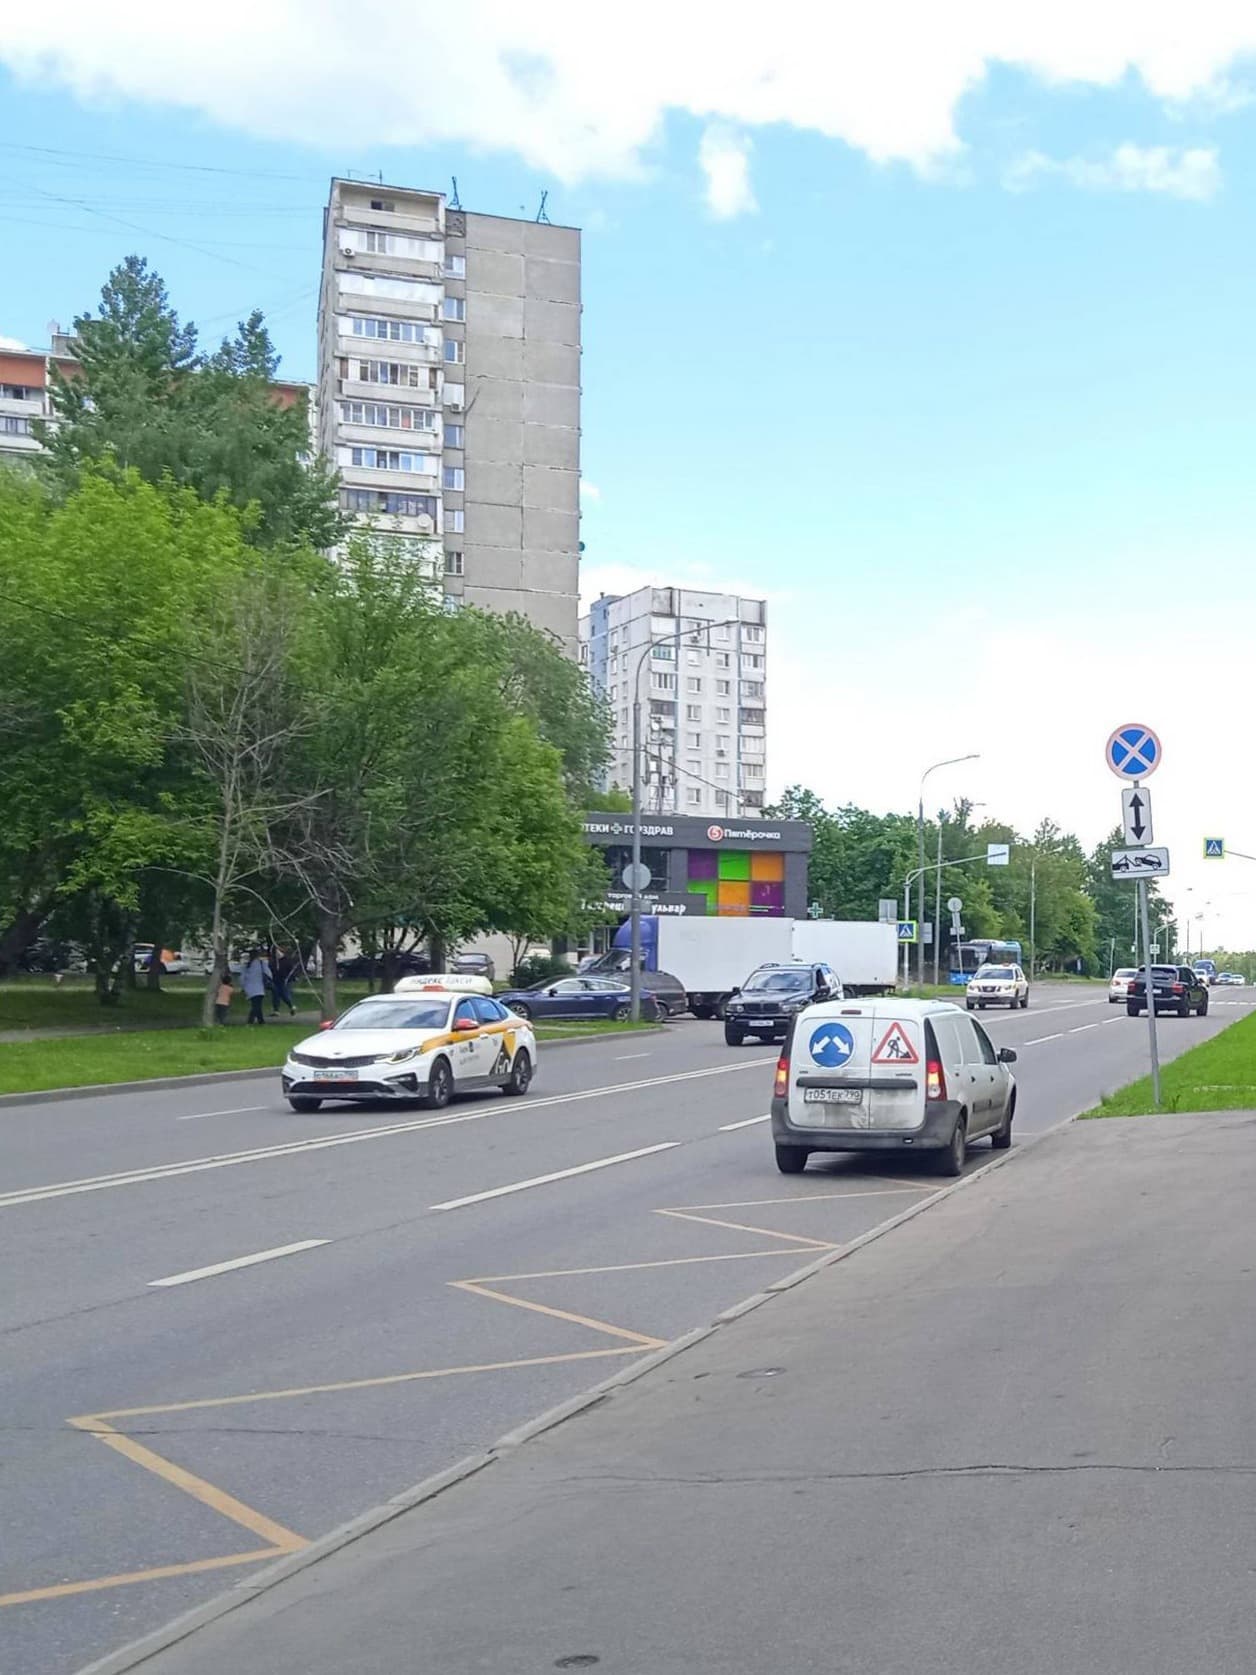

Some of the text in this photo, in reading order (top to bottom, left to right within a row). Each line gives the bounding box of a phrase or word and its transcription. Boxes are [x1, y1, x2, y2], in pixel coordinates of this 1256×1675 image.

[623, 824, 674, 836] ГОЗДРАВ
[724, 828, 781, 841] Пятёрочка
[651, 903, 687, 916] ульвар
